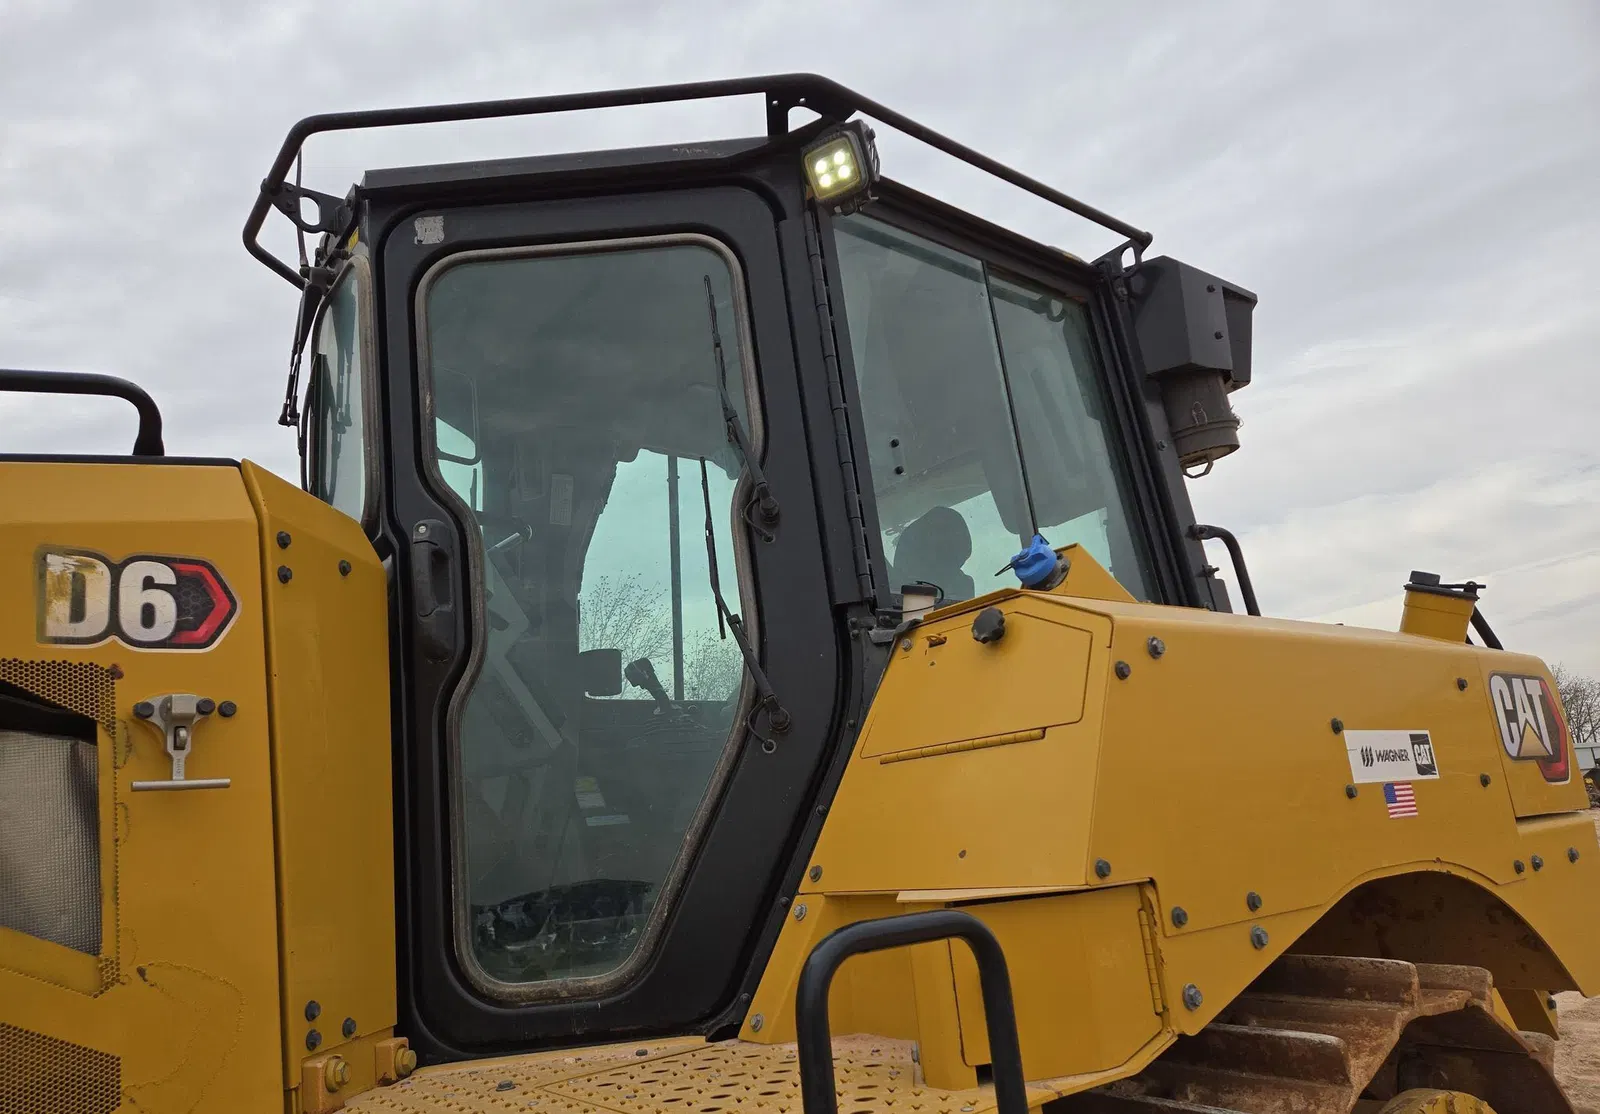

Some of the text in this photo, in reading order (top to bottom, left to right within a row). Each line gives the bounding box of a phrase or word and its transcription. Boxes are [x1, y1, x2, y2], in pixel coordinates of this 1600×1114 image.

[46, 553, 177, 642] D6
[1375, 744, 1433, 765] WAGNER CAT
[1491, 675, 1553, 757] CAT
